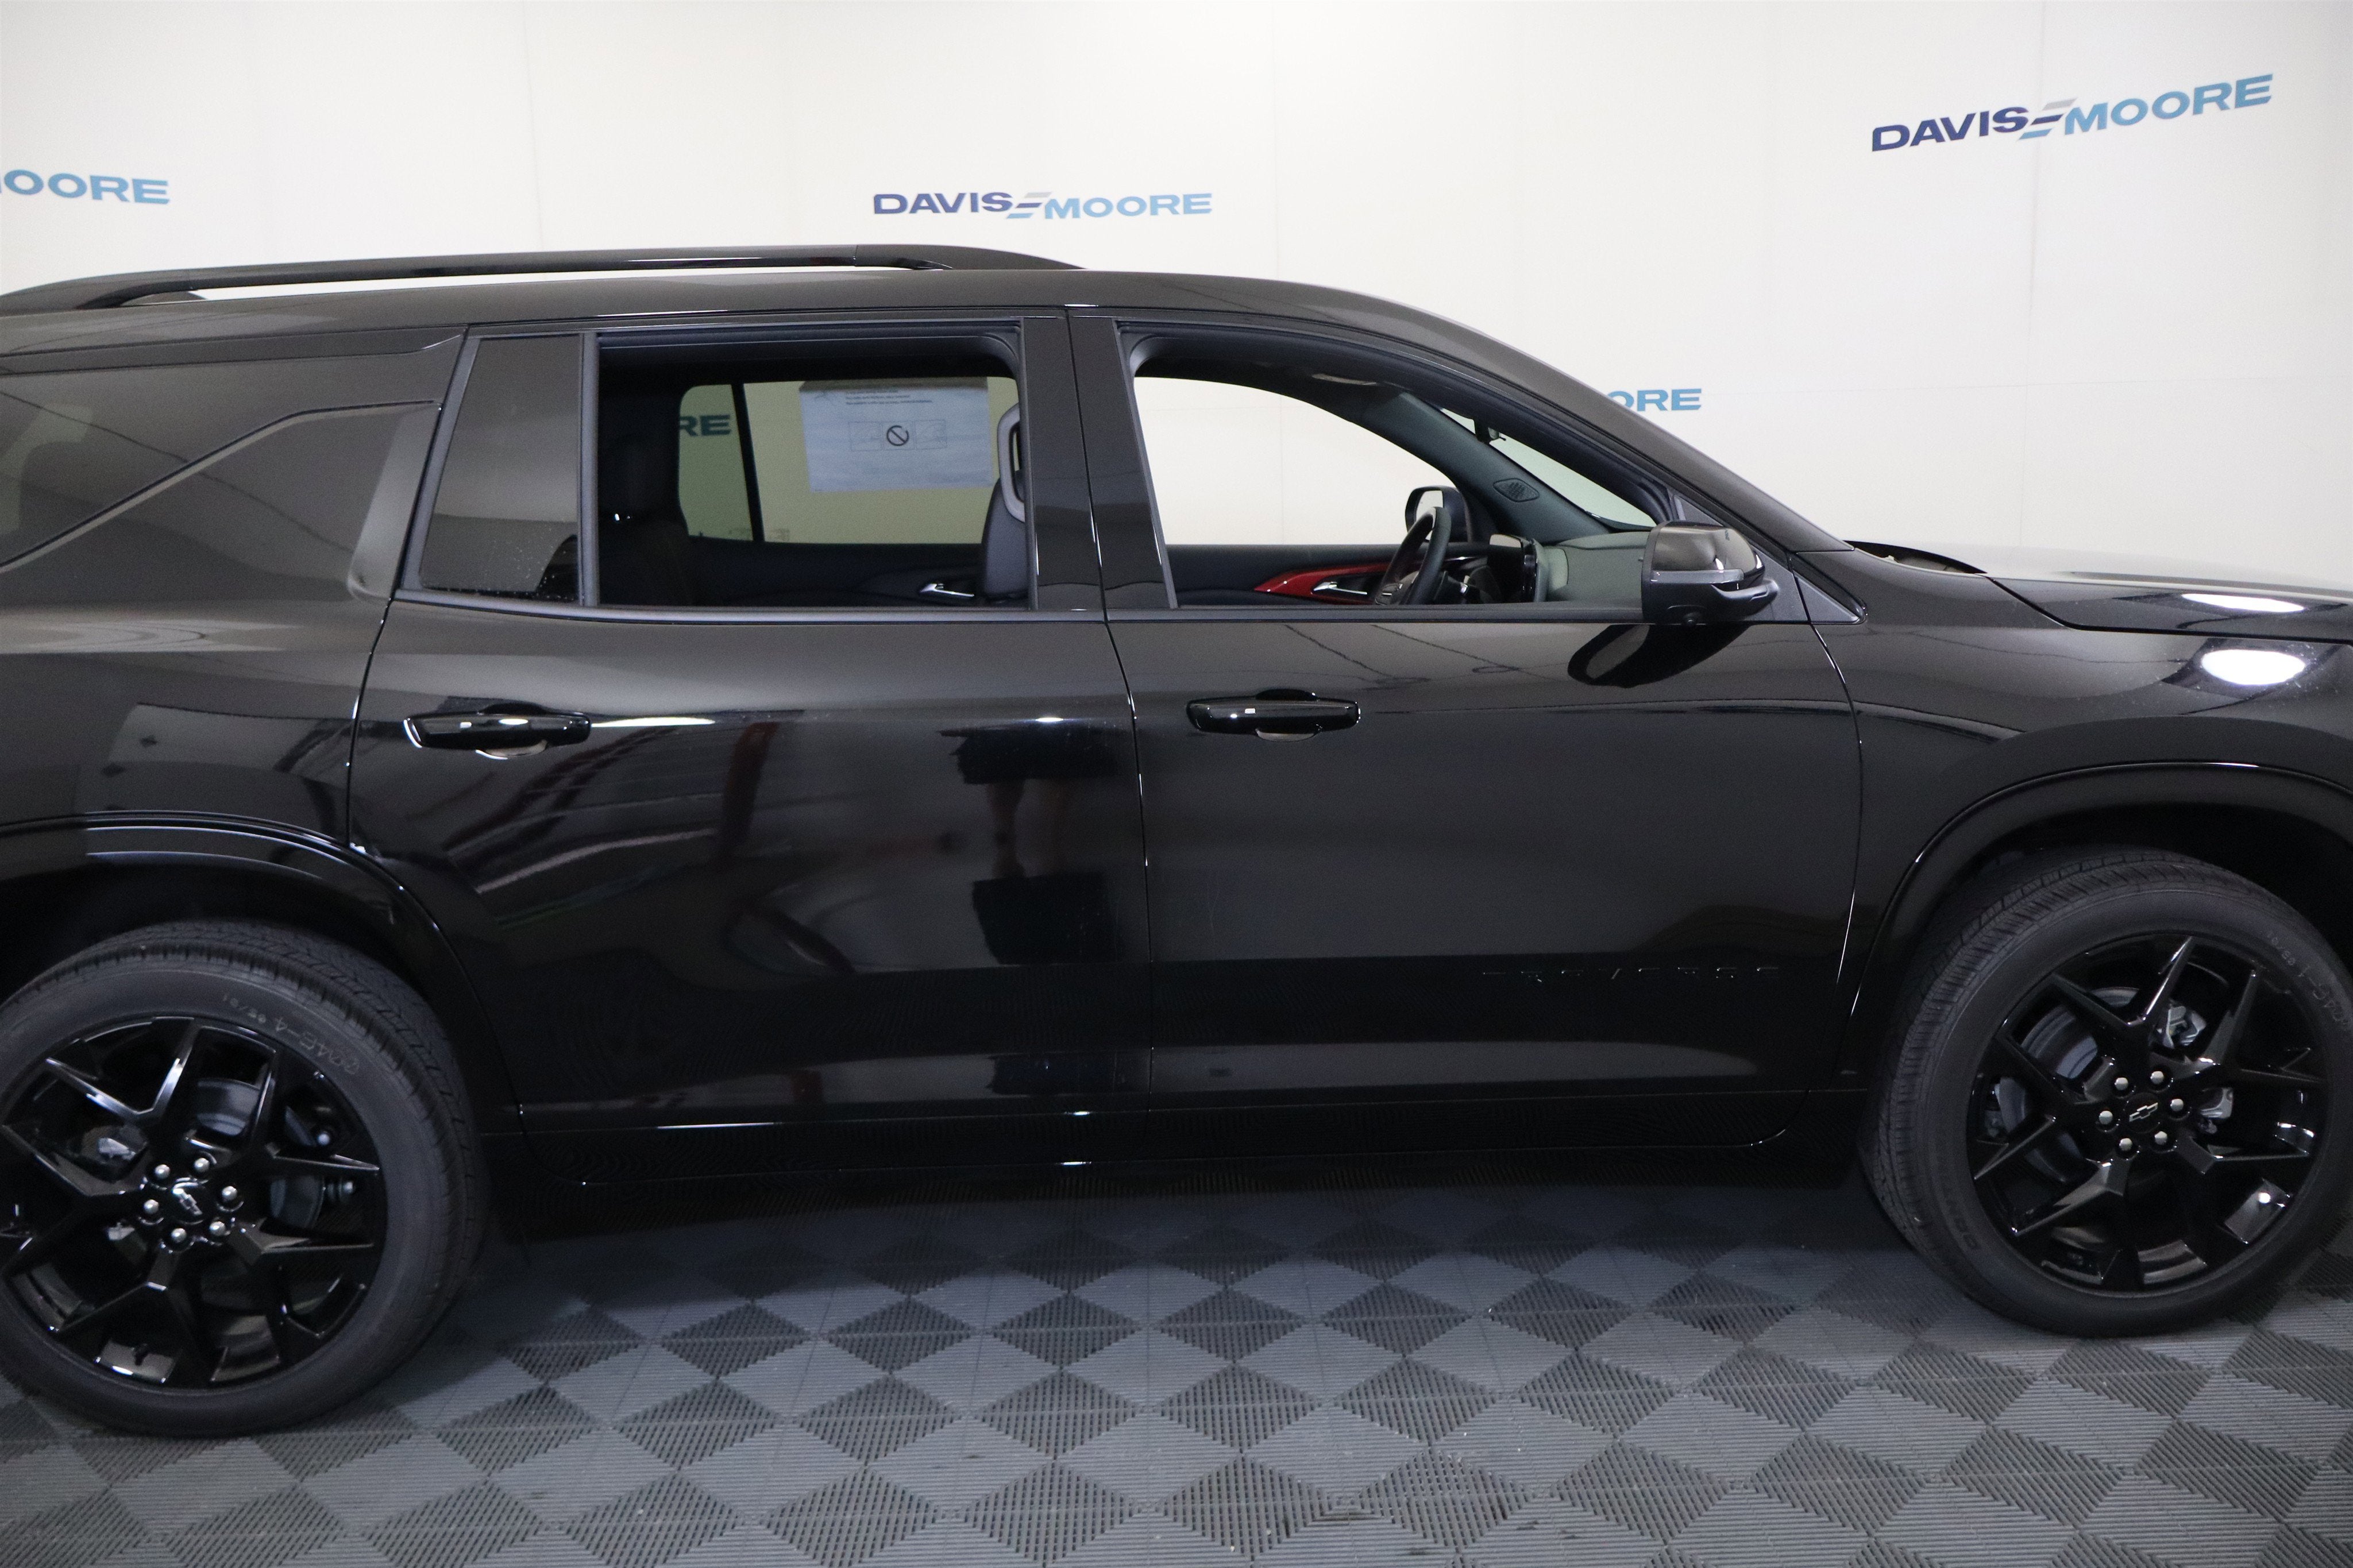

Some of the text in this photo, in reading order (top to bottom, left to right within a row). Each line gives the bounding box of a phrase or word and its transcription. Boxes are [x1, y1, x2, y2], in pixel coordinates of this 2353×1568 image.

[1872, 74, 2273, 152] DAVIS MOORE
[0, 169, 170, 204] OORE
[873, 192, 1212, 219] DAVIS MOORE
